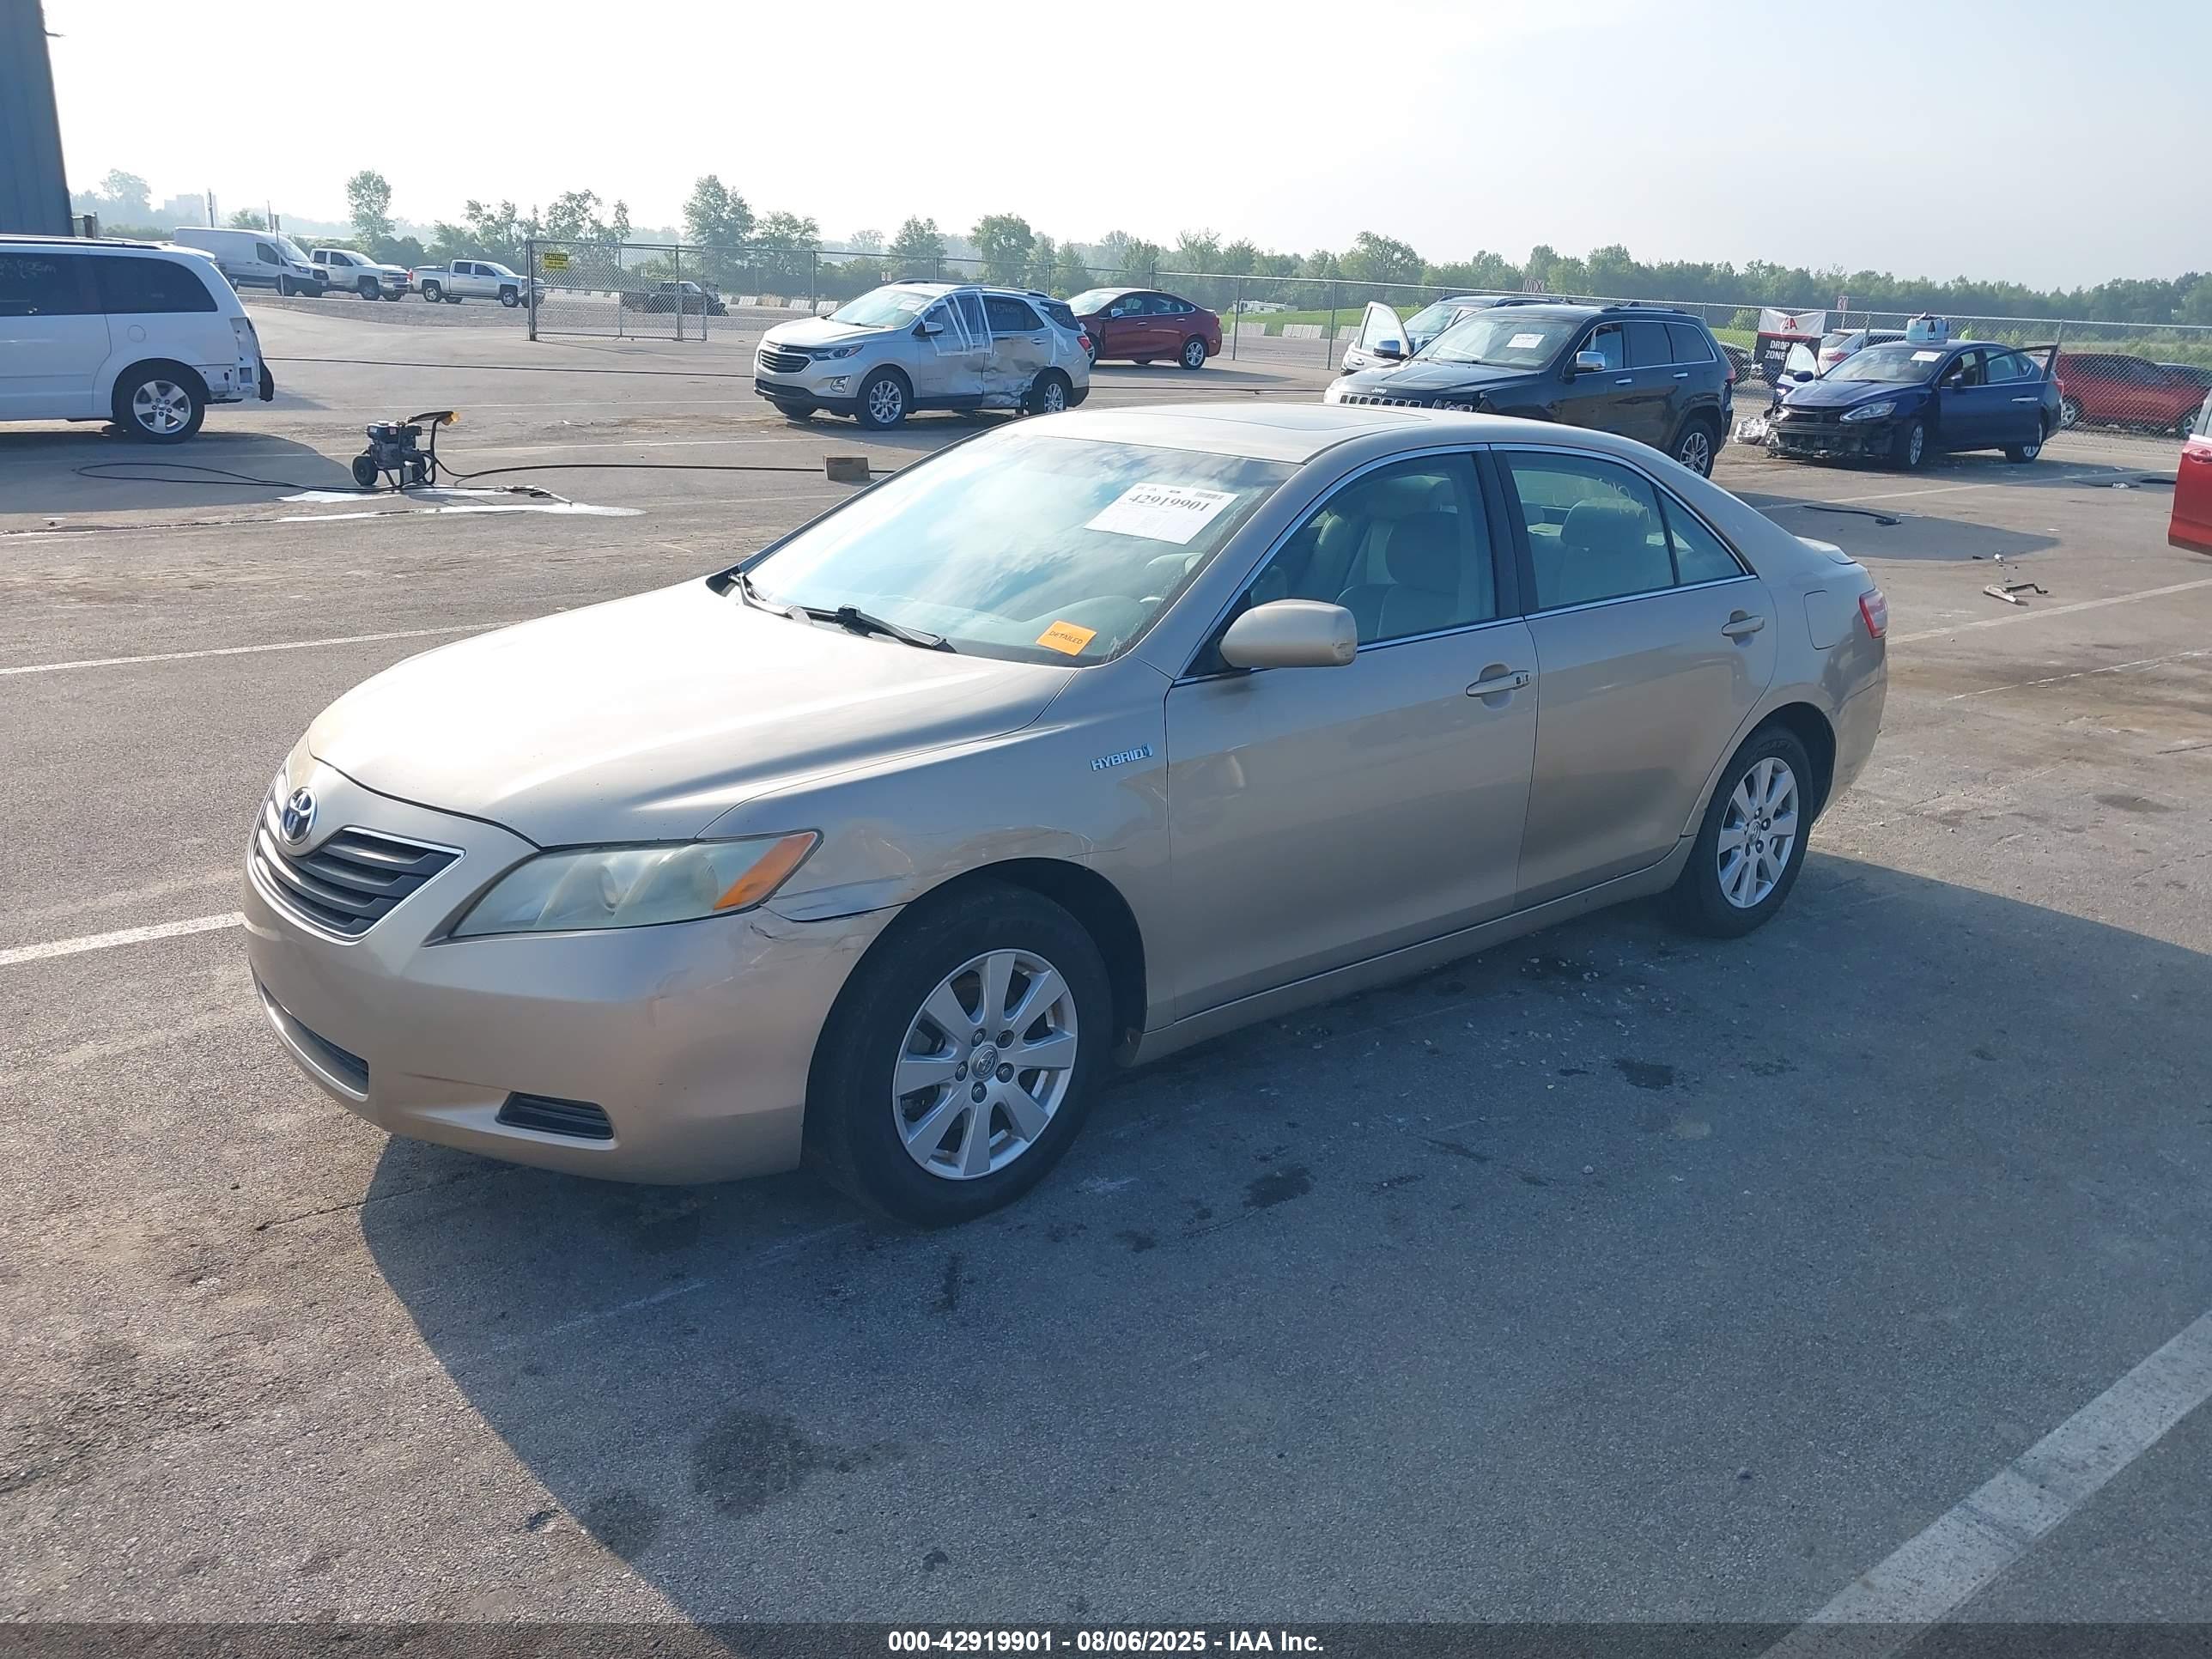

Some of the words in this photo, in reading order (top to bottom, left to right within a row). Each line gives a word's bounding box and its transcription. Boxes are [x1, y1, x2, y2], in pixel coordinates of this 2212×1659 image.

[1770, 340, 1790, 350] DROP
[1765, 349, 1785, 361] ZONE
[1128, 494, 1212, 512] 42919901
[1049, 630, 1084, 645] DETAILED
[1091, 749, 1147, 771] HYBRID
